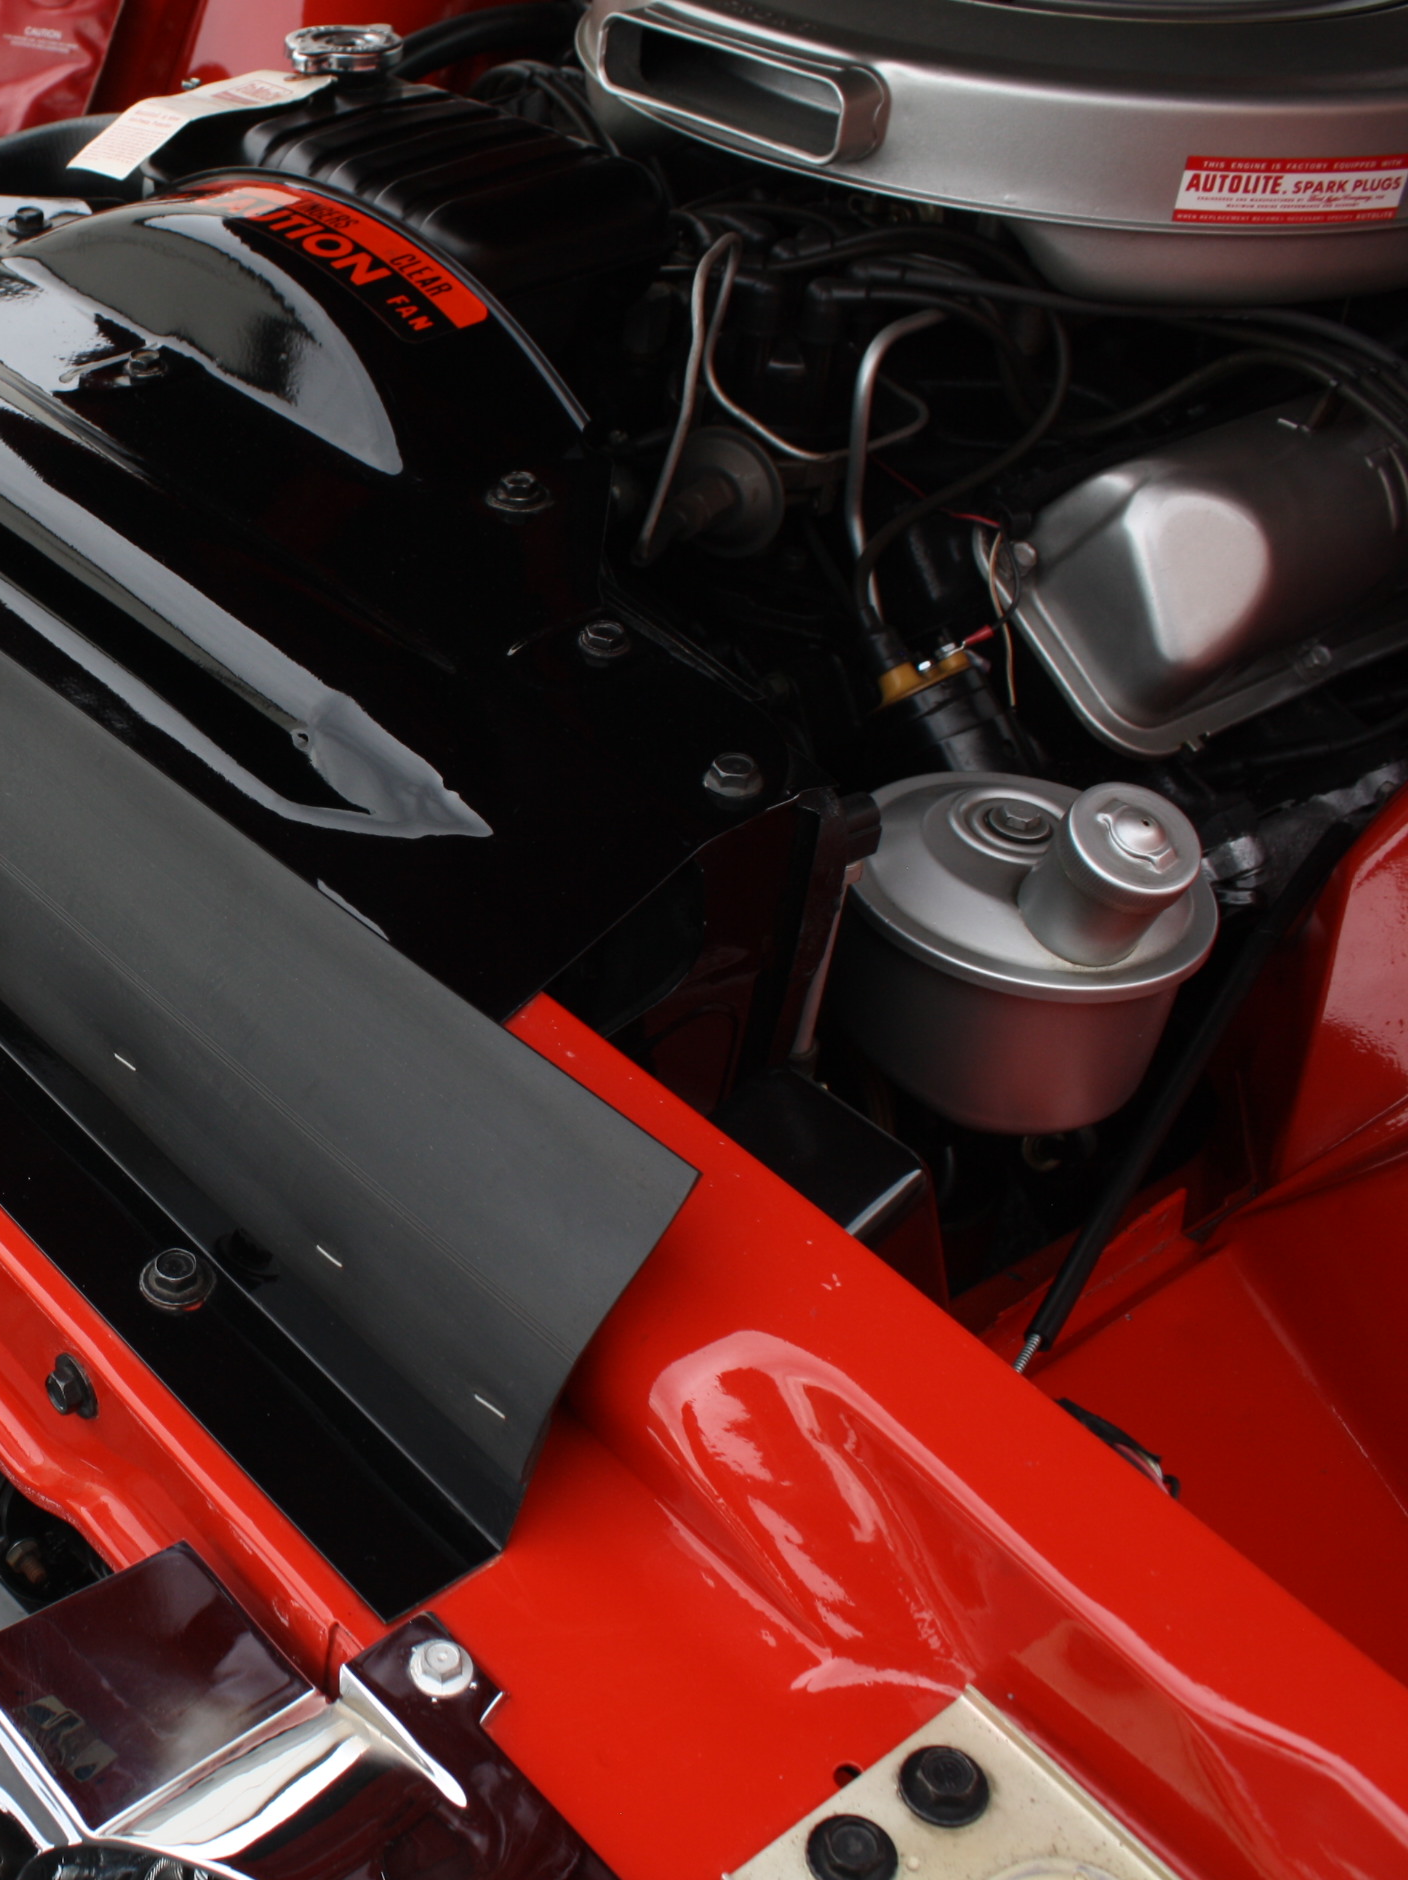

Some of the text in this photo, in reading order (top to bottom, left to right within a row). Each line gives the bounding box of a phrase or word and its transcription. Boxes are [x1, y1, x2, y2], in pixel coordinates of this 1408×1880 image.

[24, 26, 62, 40] CAUTION
[1231, 162, 1267, 170] ENGINE
[1285, 162, 1328, 170] FACTORY
[1333, 161, 1377, 169] EQUIPPED
[1380, 159, 1403, 167] WITH
[1292, 180, 1349, 194] SPARK
[1352, 176, 1402, 192] PLUGS
[295, 198, 453, 298] INGERS CLEAR
[387, 294, 434, 332] FAN
